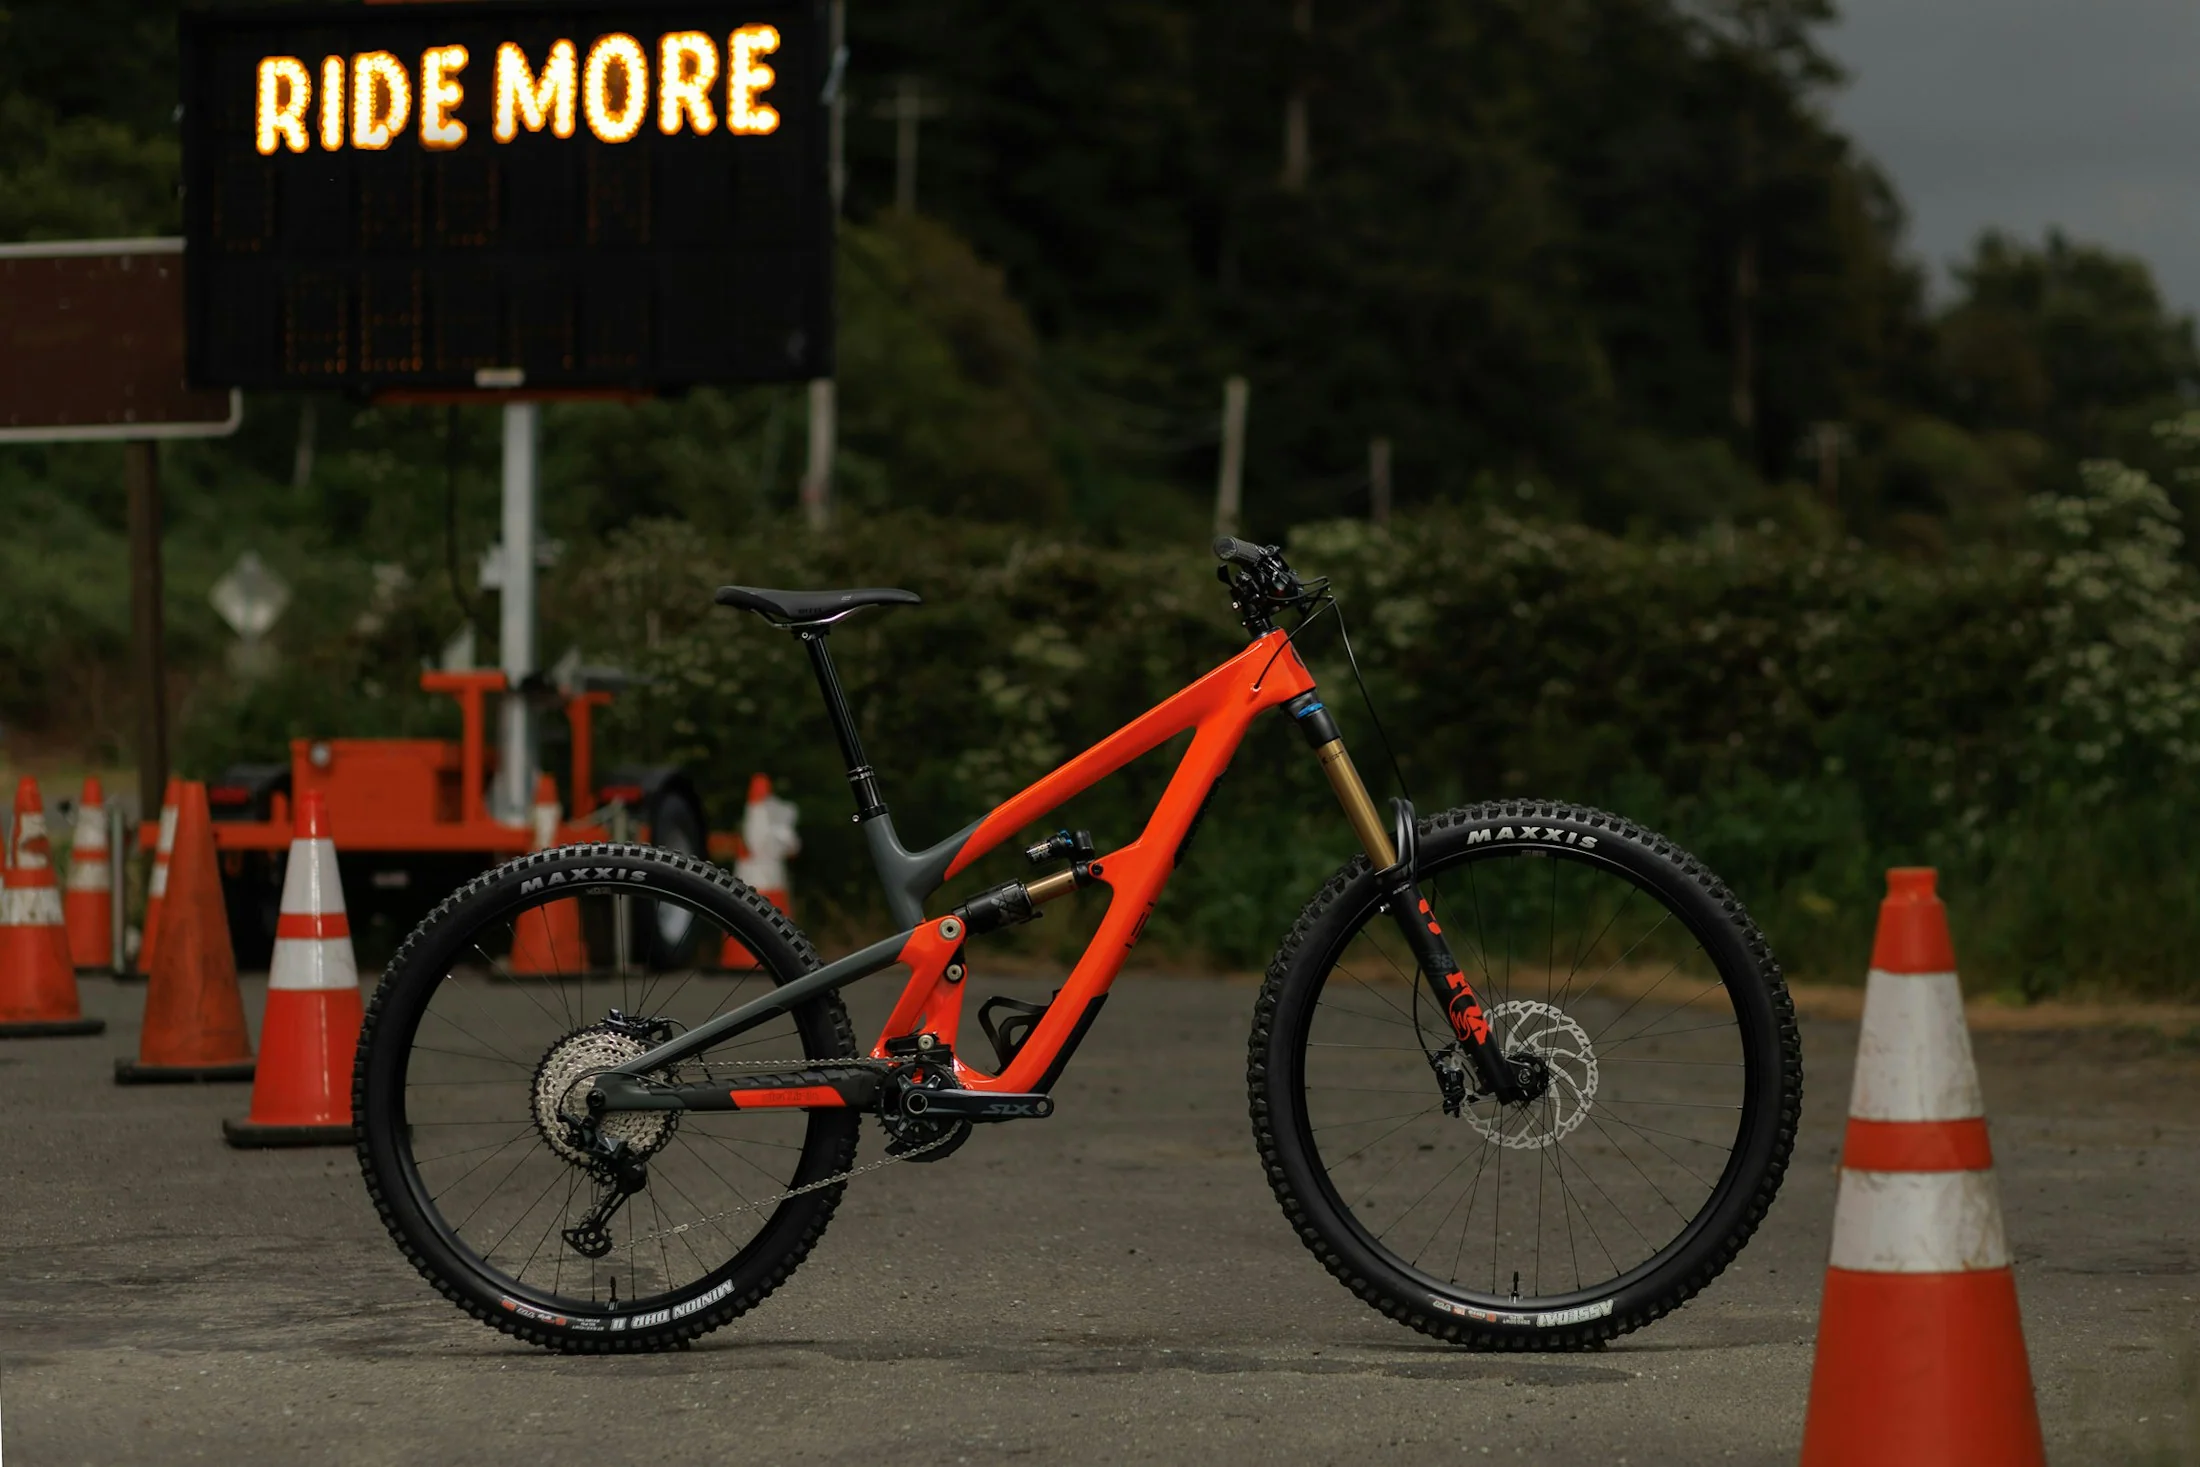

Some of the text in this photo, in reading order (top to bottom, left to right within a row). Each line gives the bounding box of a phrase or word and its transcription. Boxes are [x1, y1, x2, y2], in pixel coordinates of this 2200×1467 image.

[256, 23, 780, 154] RIDE MORE
[1467, 826, 1598, 848] MAXXIS
[521, 868, 648, 894] MAXXIS
[981, 1103, 1034, 1115] SLX
[672, 1279, 735, 1320] MINION
[631, 1309, 670, 1329] DHR
